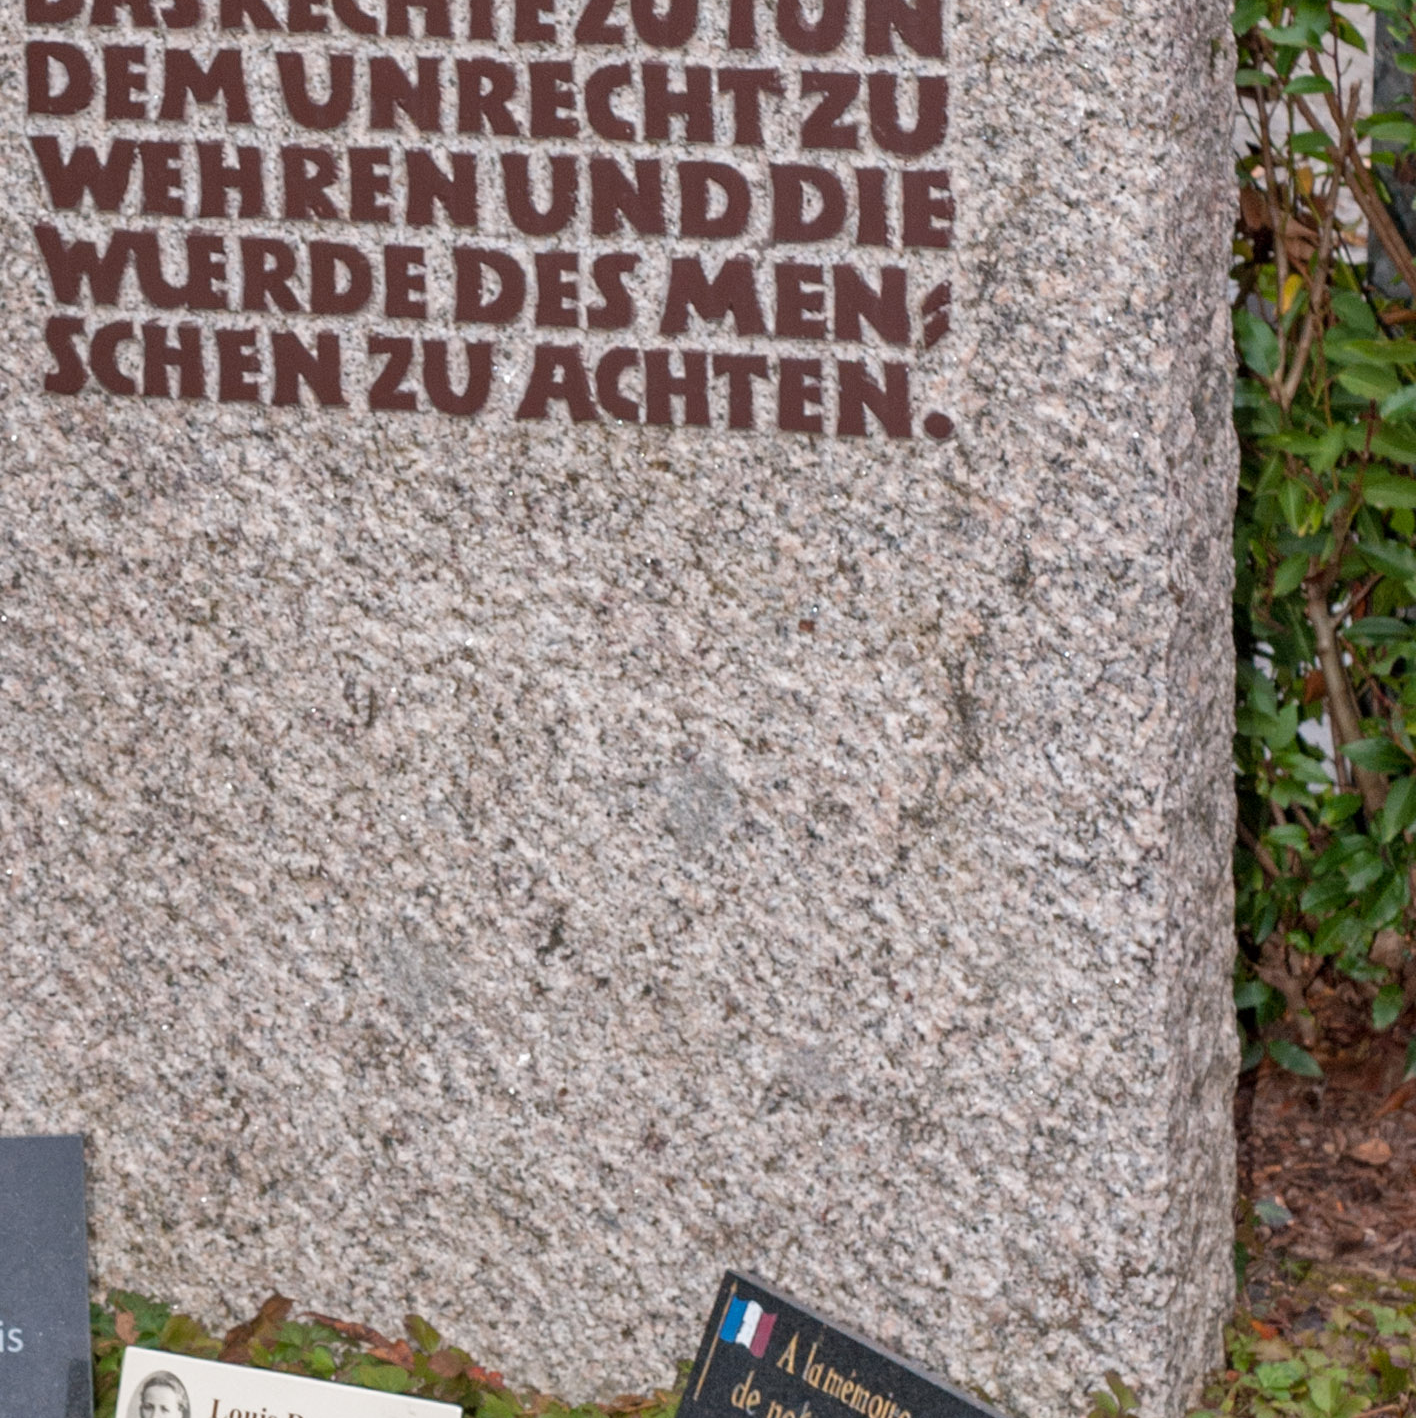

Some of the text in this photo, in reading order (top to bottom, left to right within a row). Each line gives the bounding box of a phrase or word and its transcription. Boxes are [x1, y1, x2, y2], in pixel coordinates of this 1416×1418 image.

[24, 41, 950, 159] DEM UNRECHT ZU
[31, 135, 956, 251] WEHREN UND DIE
[32, 222, 428, 323] WUERDE
[451, 246, 641, 331] DES
[42, 315, 955, 441] SCHEN ZU ACHTEN.
[730, 1368, 762, 1417] de
[775, 1330, 801, 1376] A
[801, 1340, 825, 1388] la
